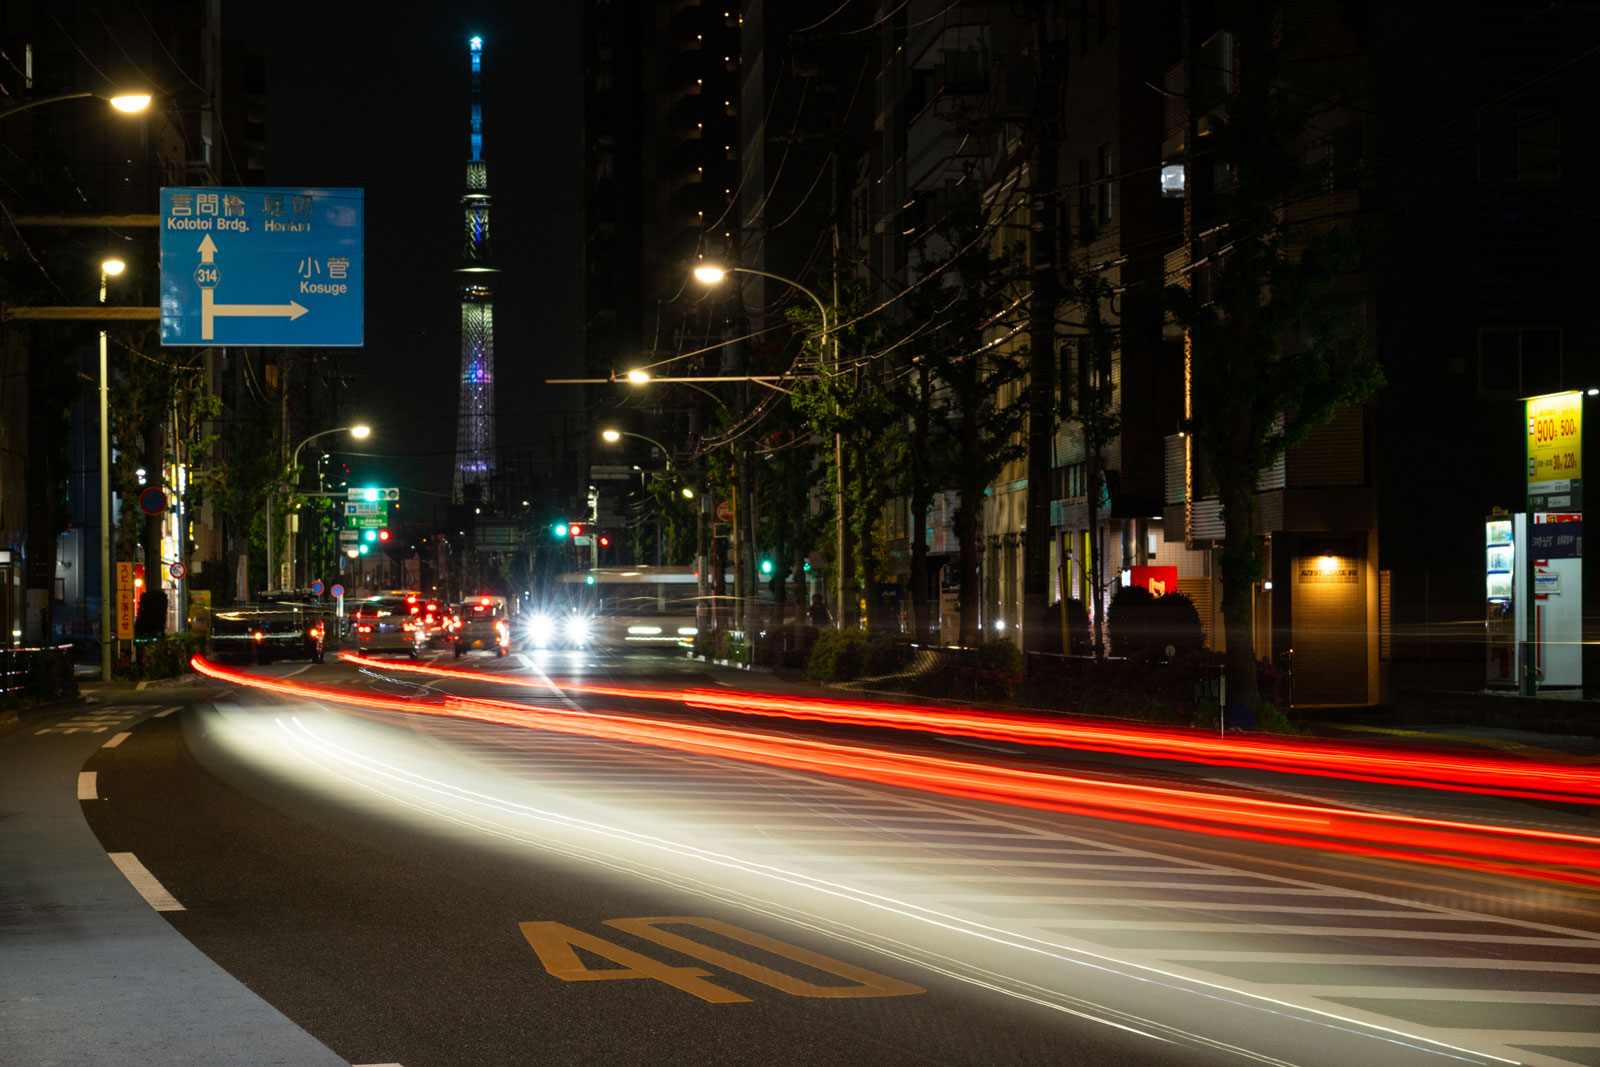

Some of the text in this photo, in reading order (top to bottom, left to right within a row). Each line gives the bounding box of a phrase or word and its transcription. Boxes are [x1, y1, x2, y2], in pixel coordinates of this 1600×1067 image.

[170, 194, 245, 216] 言問橋
[167, 217, 310, 233] Kototoi Brdg. Horikiri
[198, 269, 217, 282] 314
[298, 256, 349, 279] 小菅
[300, 281, 347, 296] Kosuge
[518, 916, 928, 1003] 40
